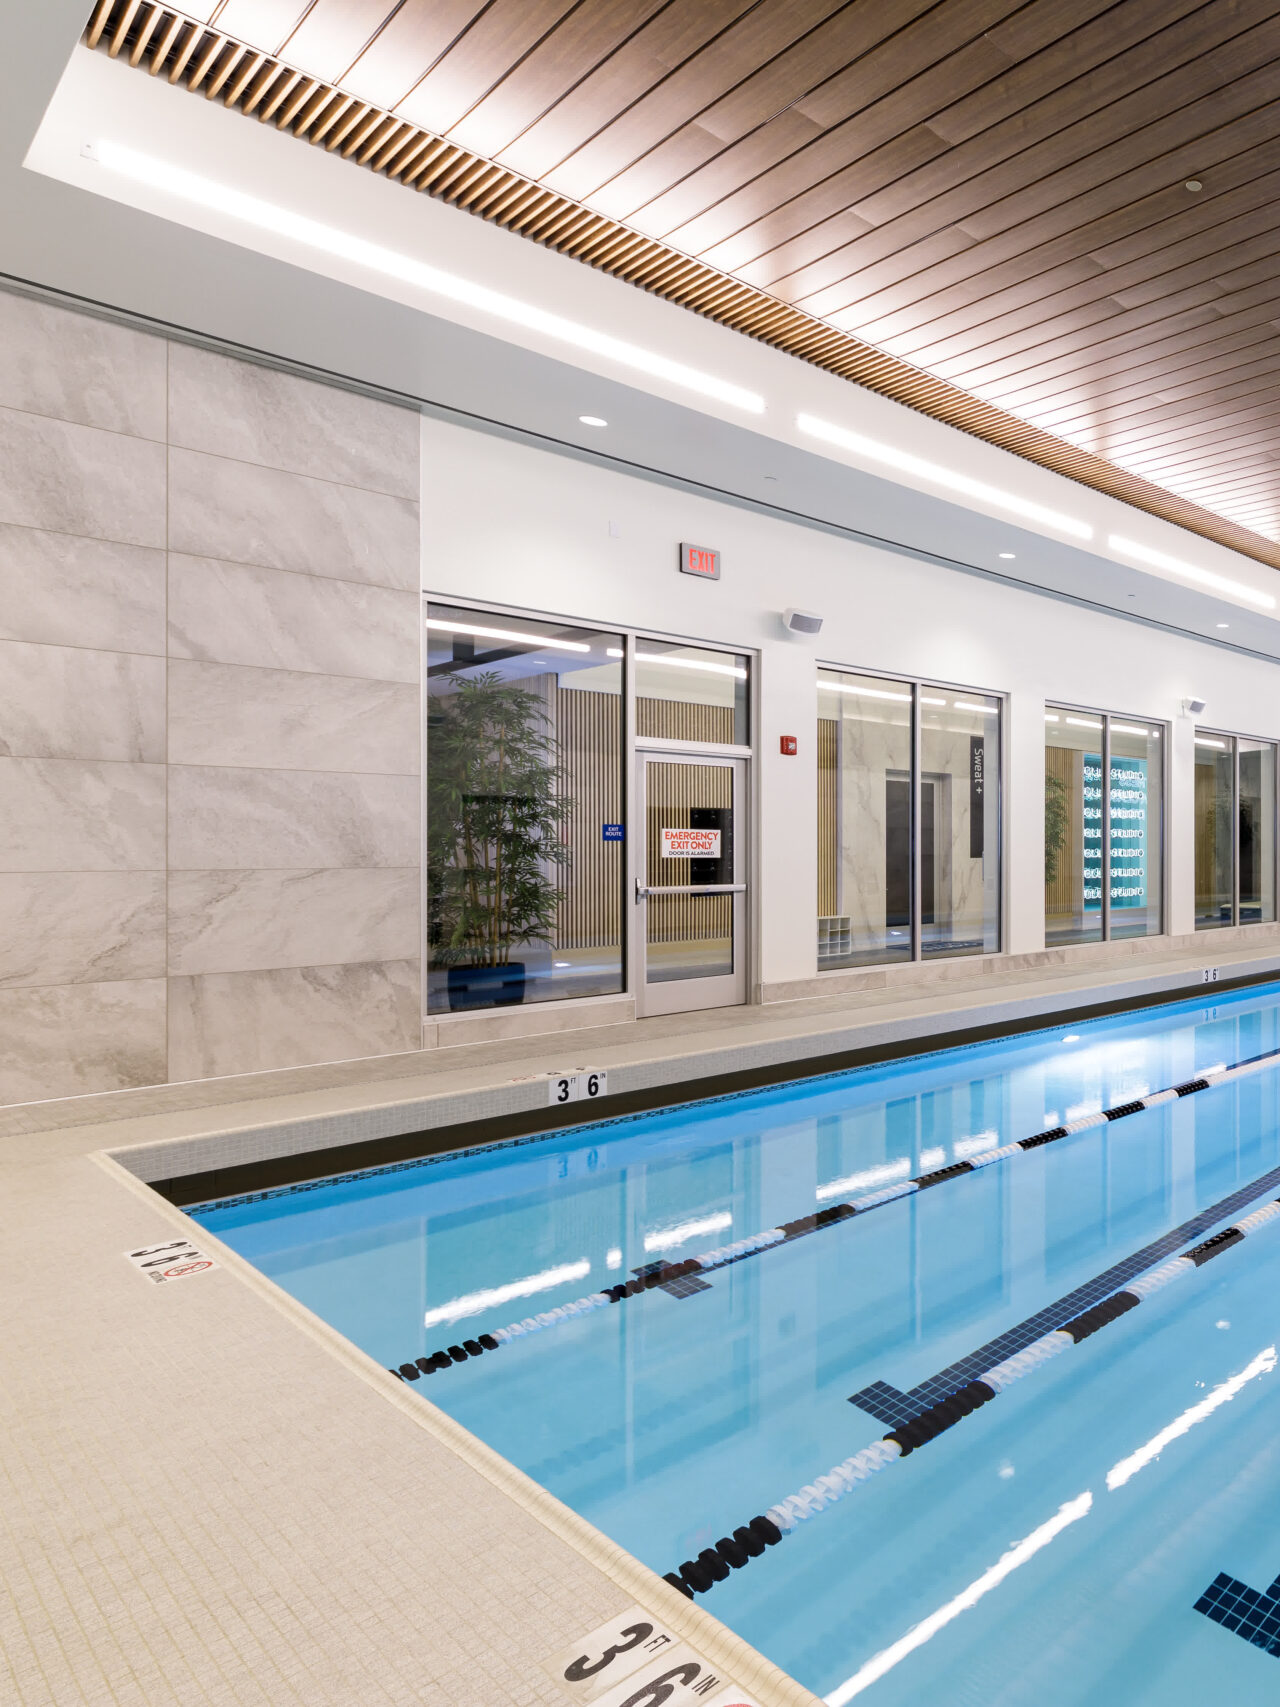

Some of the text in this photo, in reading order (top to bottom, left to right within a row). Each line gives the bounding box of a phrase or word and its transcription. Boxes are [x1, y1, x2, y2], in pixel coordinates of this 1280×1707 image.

[689, 548, 716, 574] EXIT
[974, 748, 984, 784] Sweat
[664, 831, 719, 841] EMERGENCY
[671, 841, 713, 850] EXIT ONLY
[1204, 969, 1217, 981] 3 6
[557, 1079, 569, 1102] 3
[587, 1074, 599, 1096] 6
[131, 1241, 188, 1257] 3
[141, 1252, 199, 1268] 6
[564, 1622, 671, 1682] 3 FT
[691, 1674, 720, 1696] IN
